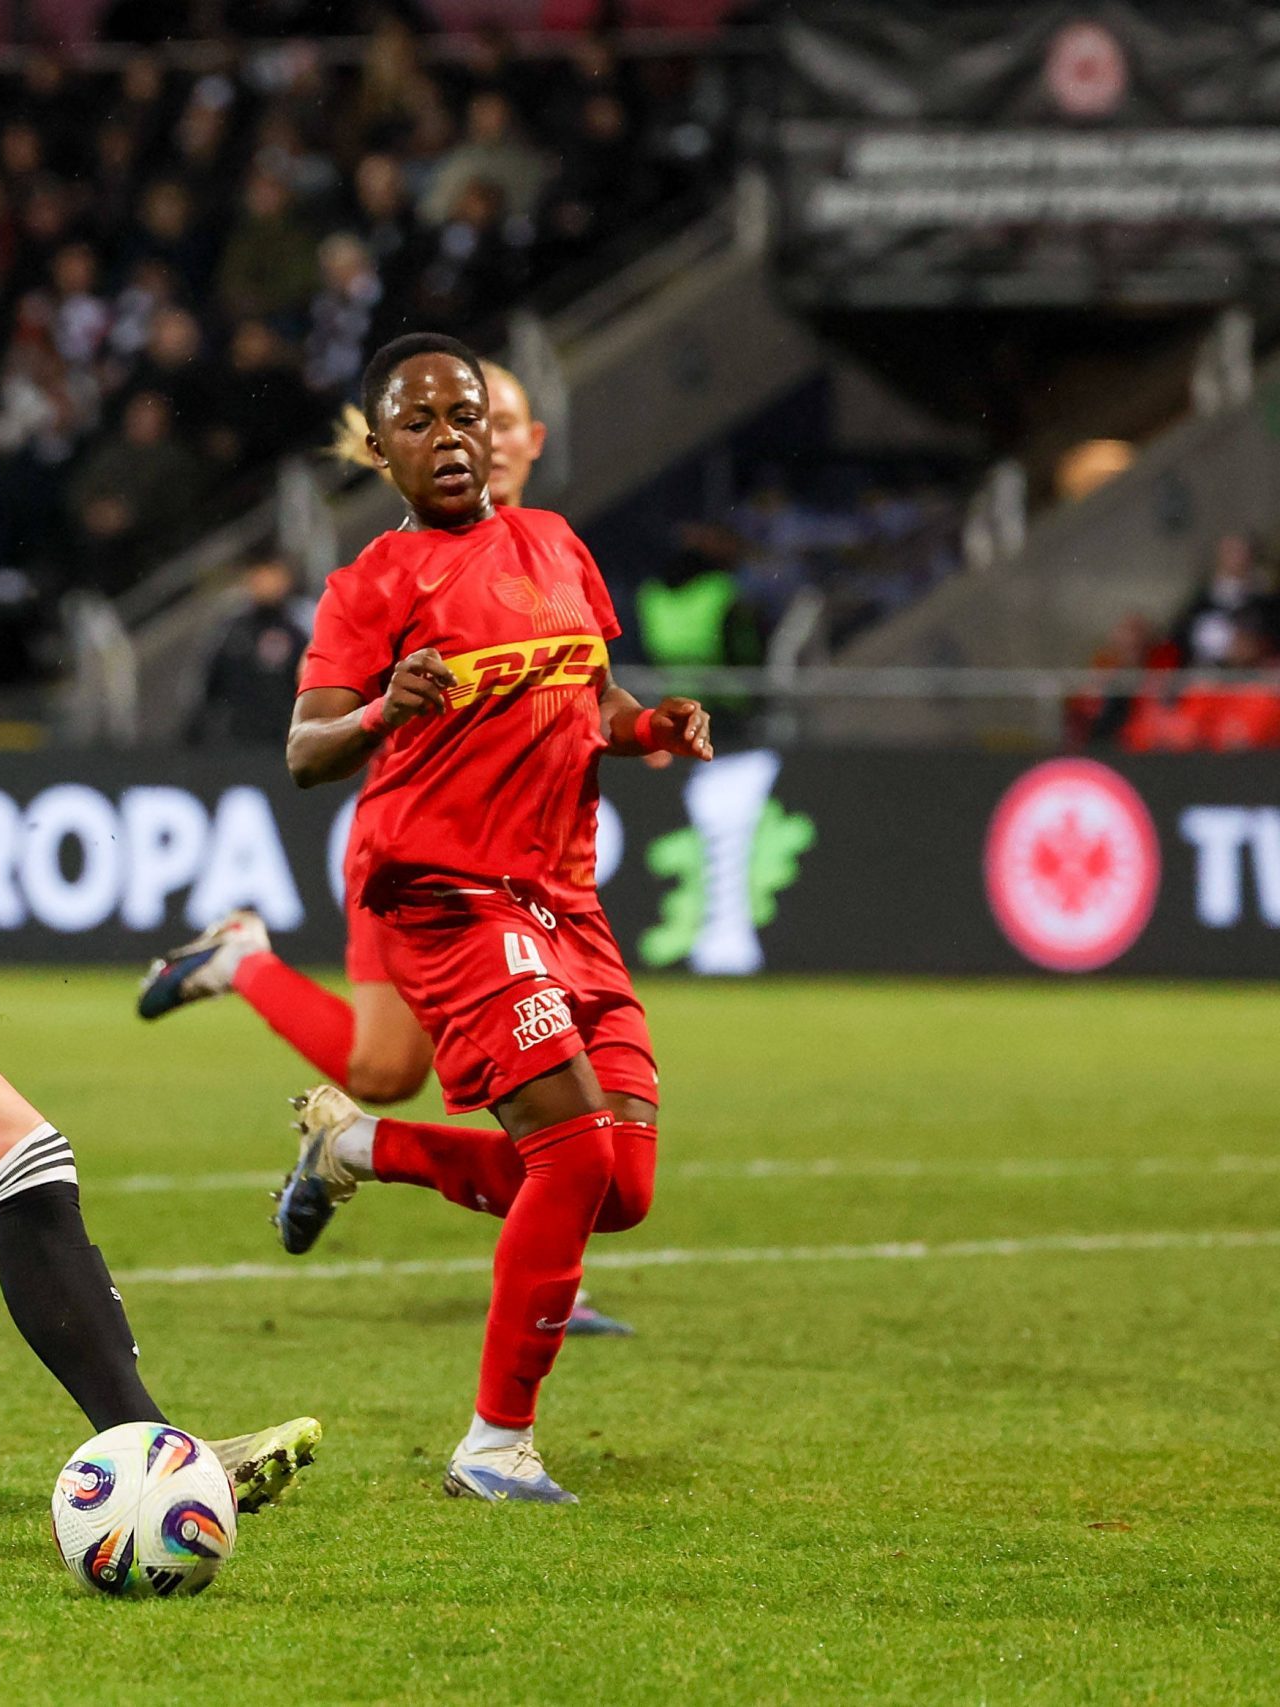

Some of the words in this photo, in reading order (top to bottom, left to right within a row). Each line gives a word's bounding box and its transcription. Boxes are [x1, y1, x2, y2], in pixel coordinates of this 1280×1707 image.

[473, 643, 597, 692] DHL
[503, 932, 548, 981] 4
[516, 989, 565, 1022] FAX
